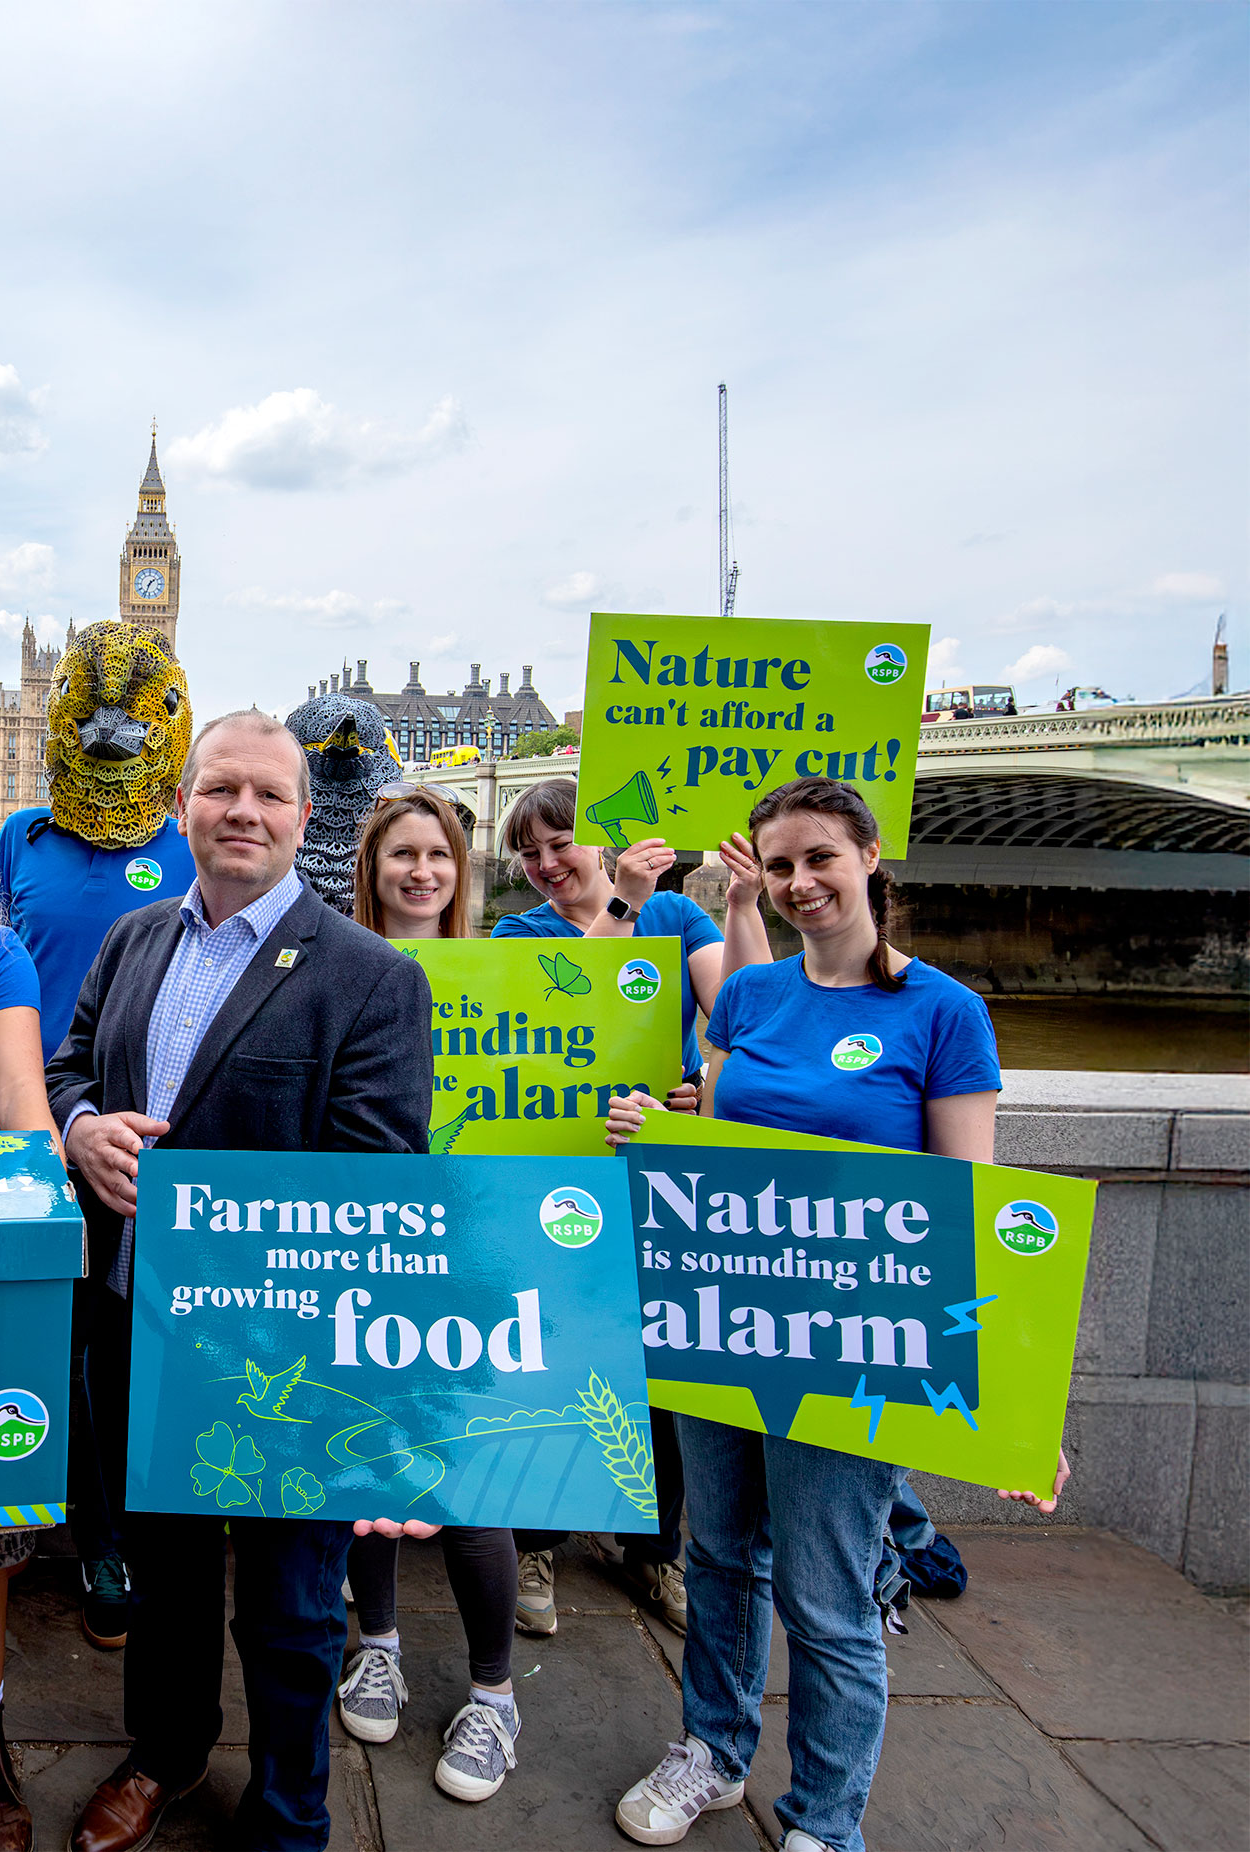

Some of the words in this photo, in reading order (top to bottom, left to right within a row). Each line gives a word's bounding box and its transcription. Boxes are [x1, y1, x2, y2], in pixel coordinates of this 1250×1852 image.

[608, 639, 811, 691] Nature
[871, 667, 899, 679] RSPB
[605, 698, 690, 727] can't
[699, 700, 805, 731] afford
[815, 711, 836, 732] a
[683, 744, 784, 791] pay
[794, 738, 901, 782] cut!
[131, 874, 155, 886] RSPB
[460, 994, 483, 1018] is
[625, 985, 654, 995] RSPB
[837, 1055, 868, 1065] RSPB
[171, 1183, 447, 1238] Farmers:
[639, 1171, 931, 1245] Nature
[553, 1222, 593, 1237] RSPB
[1005, 1230, 1046, 1249] RSPB
[265, 1246, 359, 1271] more
[365, 1242, 449, 1275] than
[642, 1240, 671, 1271] is
[681, 1247, 858, 1291] sounding
[868, 1253, 931, 1286] the
[170, 1279, 320, 1320] growing
[328, 1287, 549, 1374] food
[642, 1285, 933, 1370] alarm
